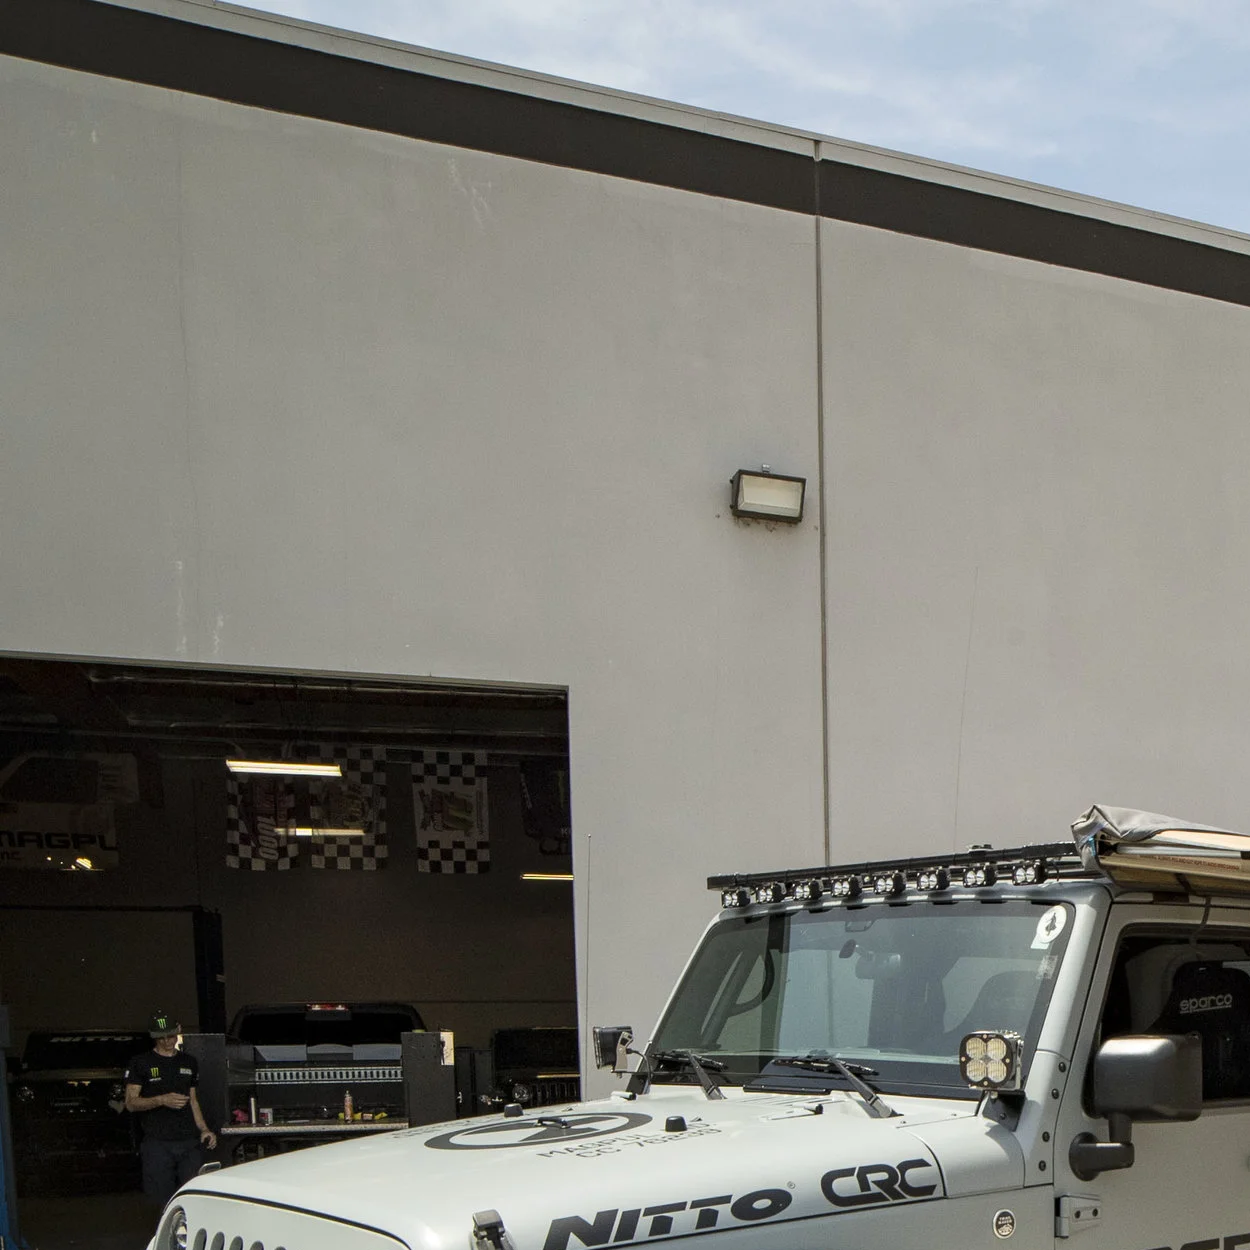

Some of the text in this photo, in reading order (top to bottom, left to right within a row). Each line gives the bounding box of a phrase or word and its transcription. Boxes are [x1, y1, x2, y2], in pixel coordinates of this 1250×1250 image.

[1180, 994, 1232, 1013] sparco
[536, 1133, 662, 1158] MAGPUL
[820, 1158, 938, 1207] CRC
